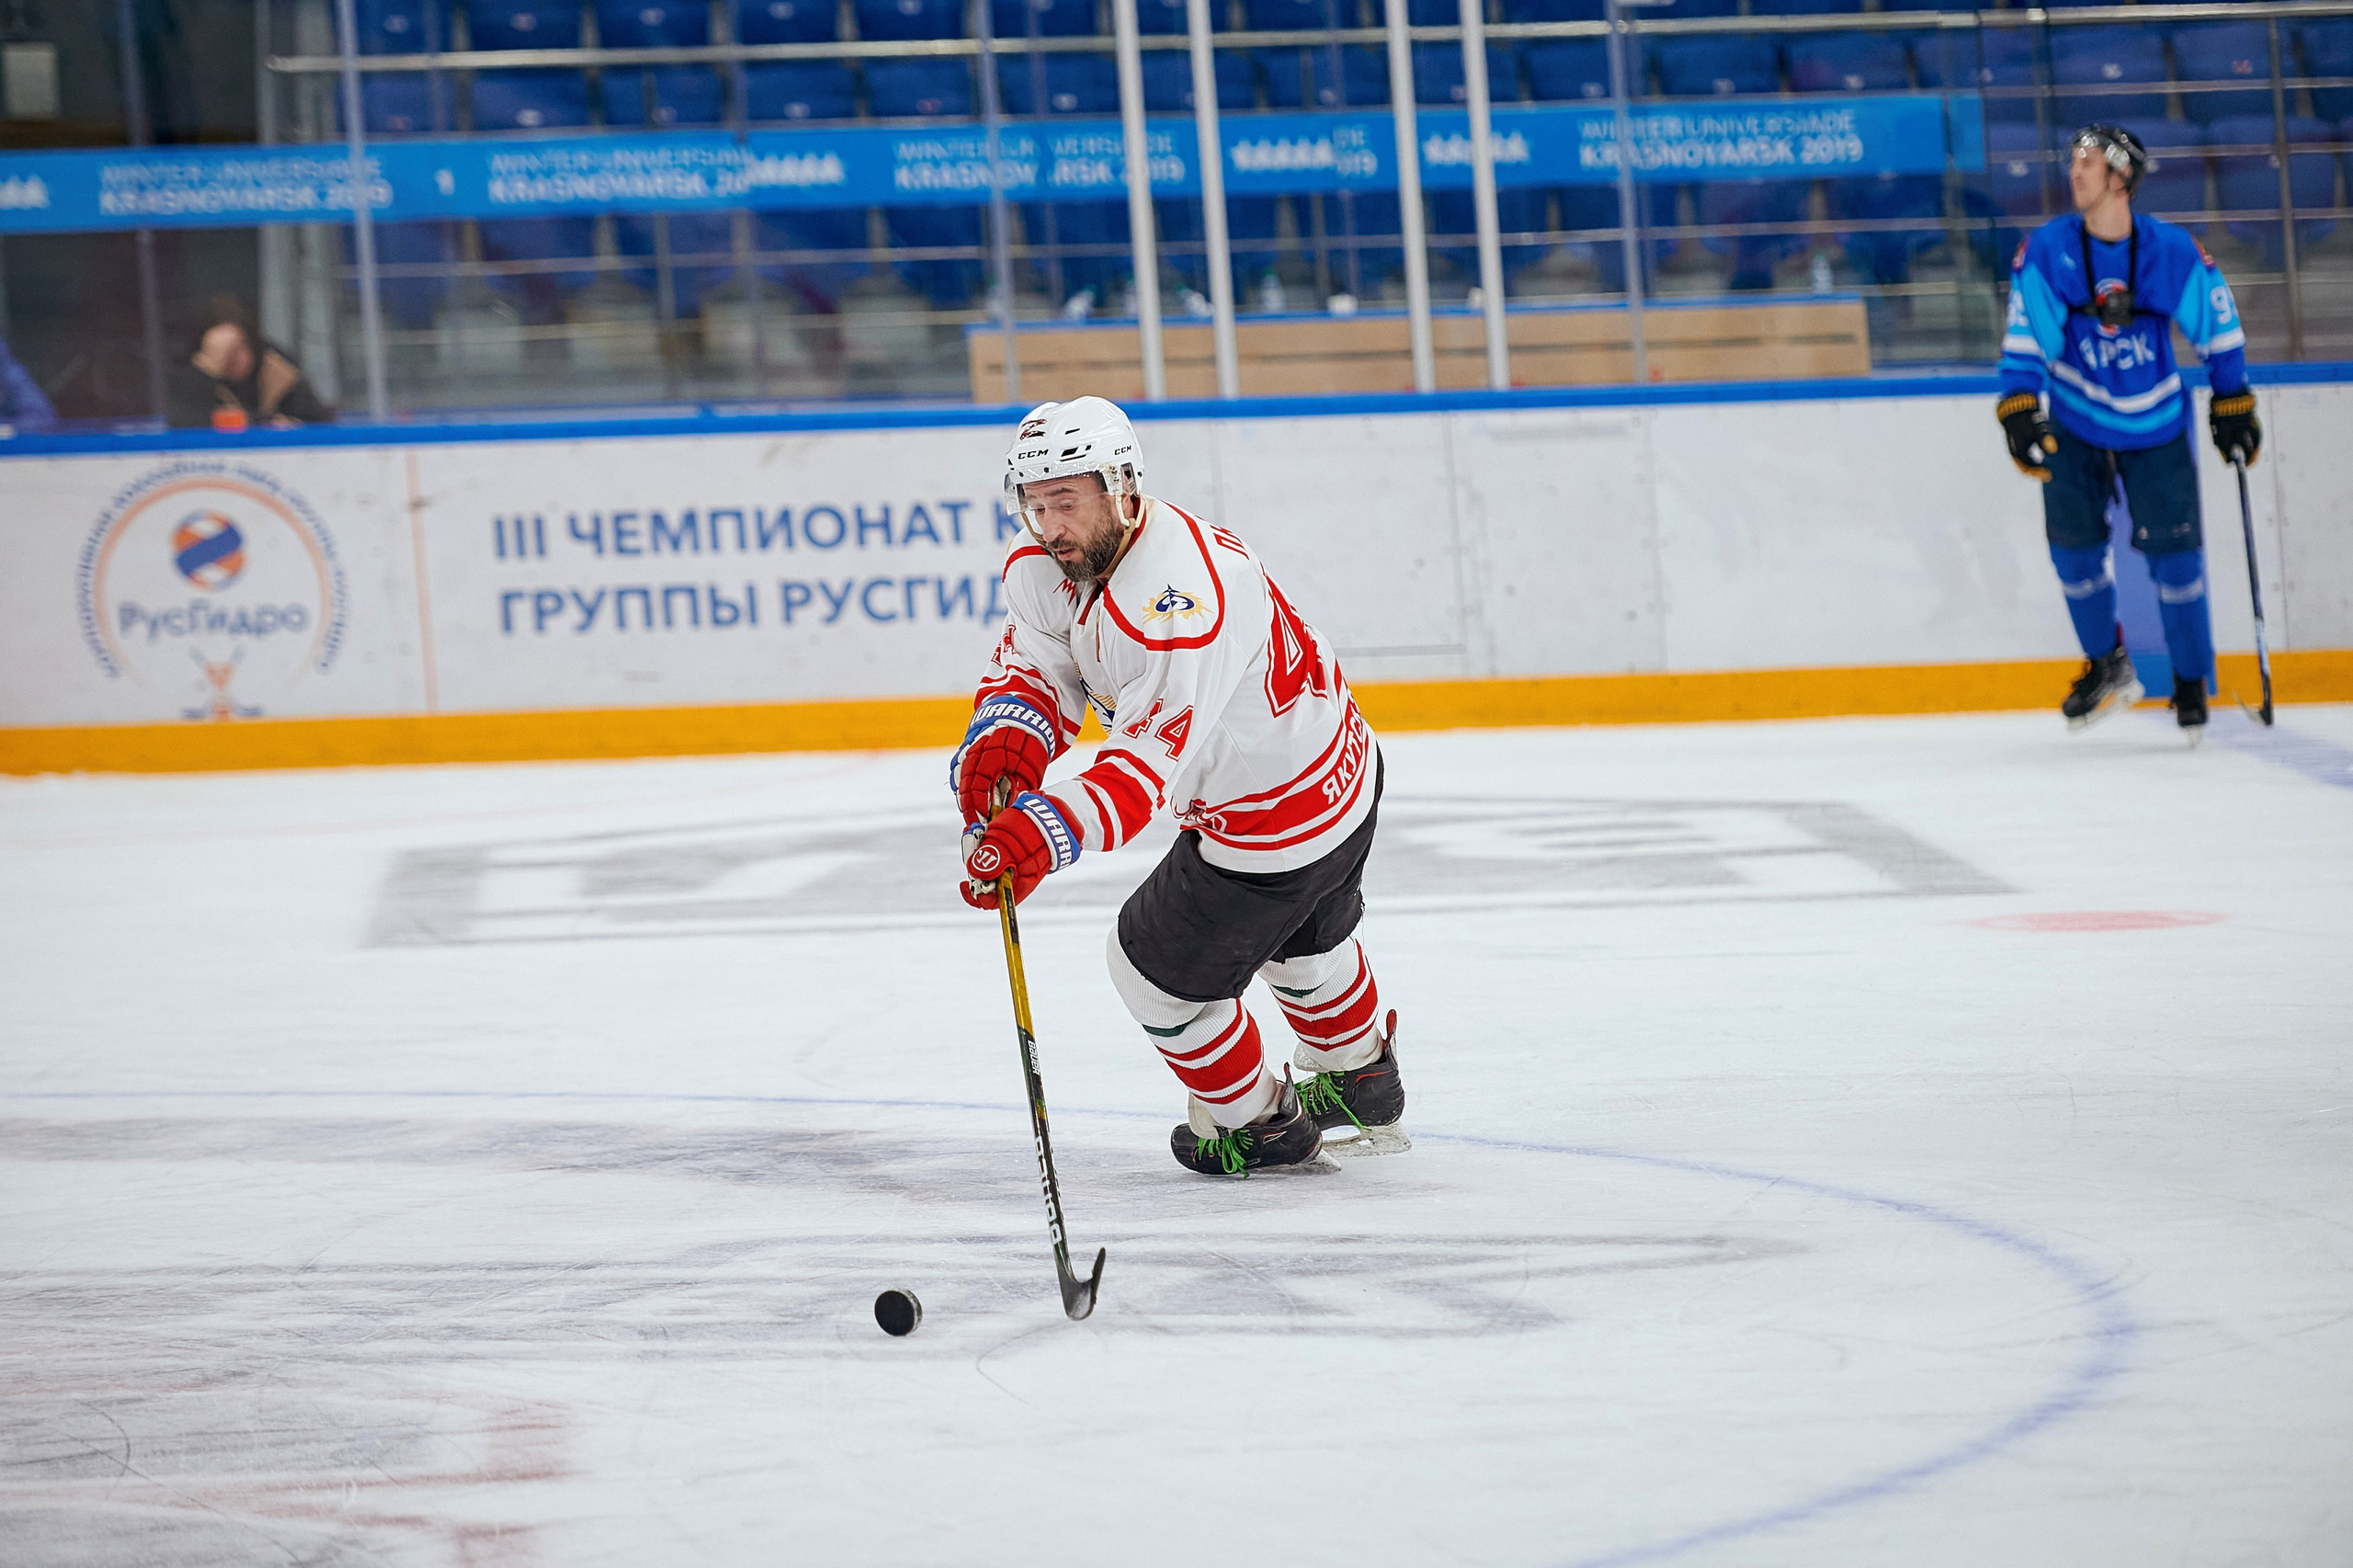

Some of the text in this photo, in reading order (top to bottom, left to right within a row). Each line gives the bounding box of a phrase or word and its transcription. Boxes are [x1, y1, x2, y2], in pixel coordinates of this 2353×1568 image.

[1579, 131, 1865, 170] KRASNOYARSK 2019
[1017, 449, 1050, 460] CCM
[1114, 445, 1132, 456] CCM
[493, 513, 548, 558] III
[566, 501, 972, 556] ЧЕМПИОНАТ
[118, 598, 310, 643] РусГидро
[499, 574, 1009, 635] ГРУППЫ РУСГИД
